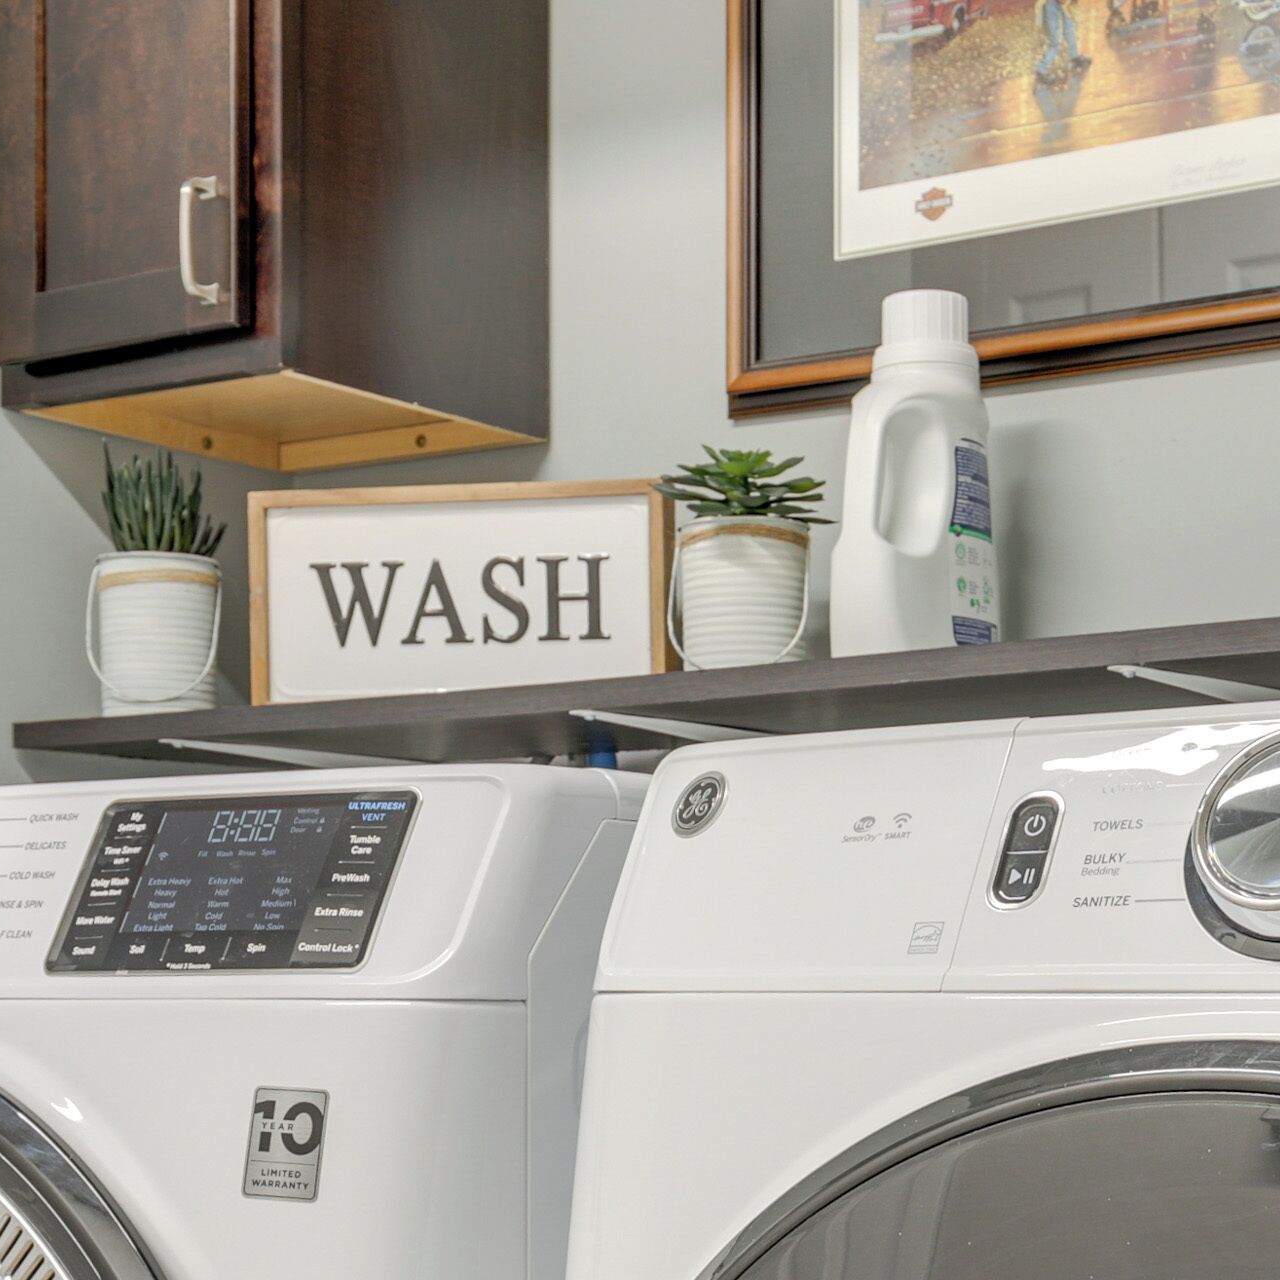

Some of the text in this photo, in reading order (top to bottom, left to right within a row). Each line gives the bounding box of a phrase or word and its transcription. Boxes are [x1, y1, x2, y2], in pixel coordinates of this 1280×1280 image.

[309, 553, 611, 648] WASH
[348, 802, 406, 811] ULTRAFRESH
[29, 813, 80, 823] QUICK WASH
[361, 813, 386, 821] VENT
[1093, 819, 1144, 832] TOWELS
[349, 835, 381, 845] Tumble
[24, 841, 68, 851] DELICATES
[350, 846, 373, 855] Care
[1084, 853, 1128, 865] BULKY
[9, 871, 56, 880] COLD WASH
[276, 876, 293, 884] Max
[332, 873, 370, 883] PreWash
[90, 879, 111, 888] Delay
[148, 877, 192, 887] Extra Heavy
[208, 877, 244, 886] Extra Hot
[154, 889, 177, 898] Heavy
[214, 888, 229, 897] Hot
[271, 886, 290, 896] High
[24, 900, 44, 908] SPIN
[148, 901, 176, 909] Normal
[207, 900, 229, 908] Warm
[261, 899, 293, 908] Medium
[1072, 895, 1131, 908] SANITIZE
[148, 912, 167, 921] Light
[205, 911, 223, 920] Cold
[265, 911, 281, 920] Low
[314, 907, 364, 917] Extra Rinse
[133, 923, 174, 932] Extra Light
[208, 923, 227, 931] Cold
[6, 930, 33, 939] CLEAN
[72, 946, 96, 956] Sound
[129, 945, 145, 954] Soil
[184, 944, 206, 954] Temp
[247, 943, 266, 954] Spin
[298, 943, 353, 952] Control Lock
[254, 1100, 324, 1156] 10
[262, 1122, 294, 1131] YEAR
[261, 1169, 301, 1179] LIMITED
[252, 1179, 310, 1191] WARRANTY
